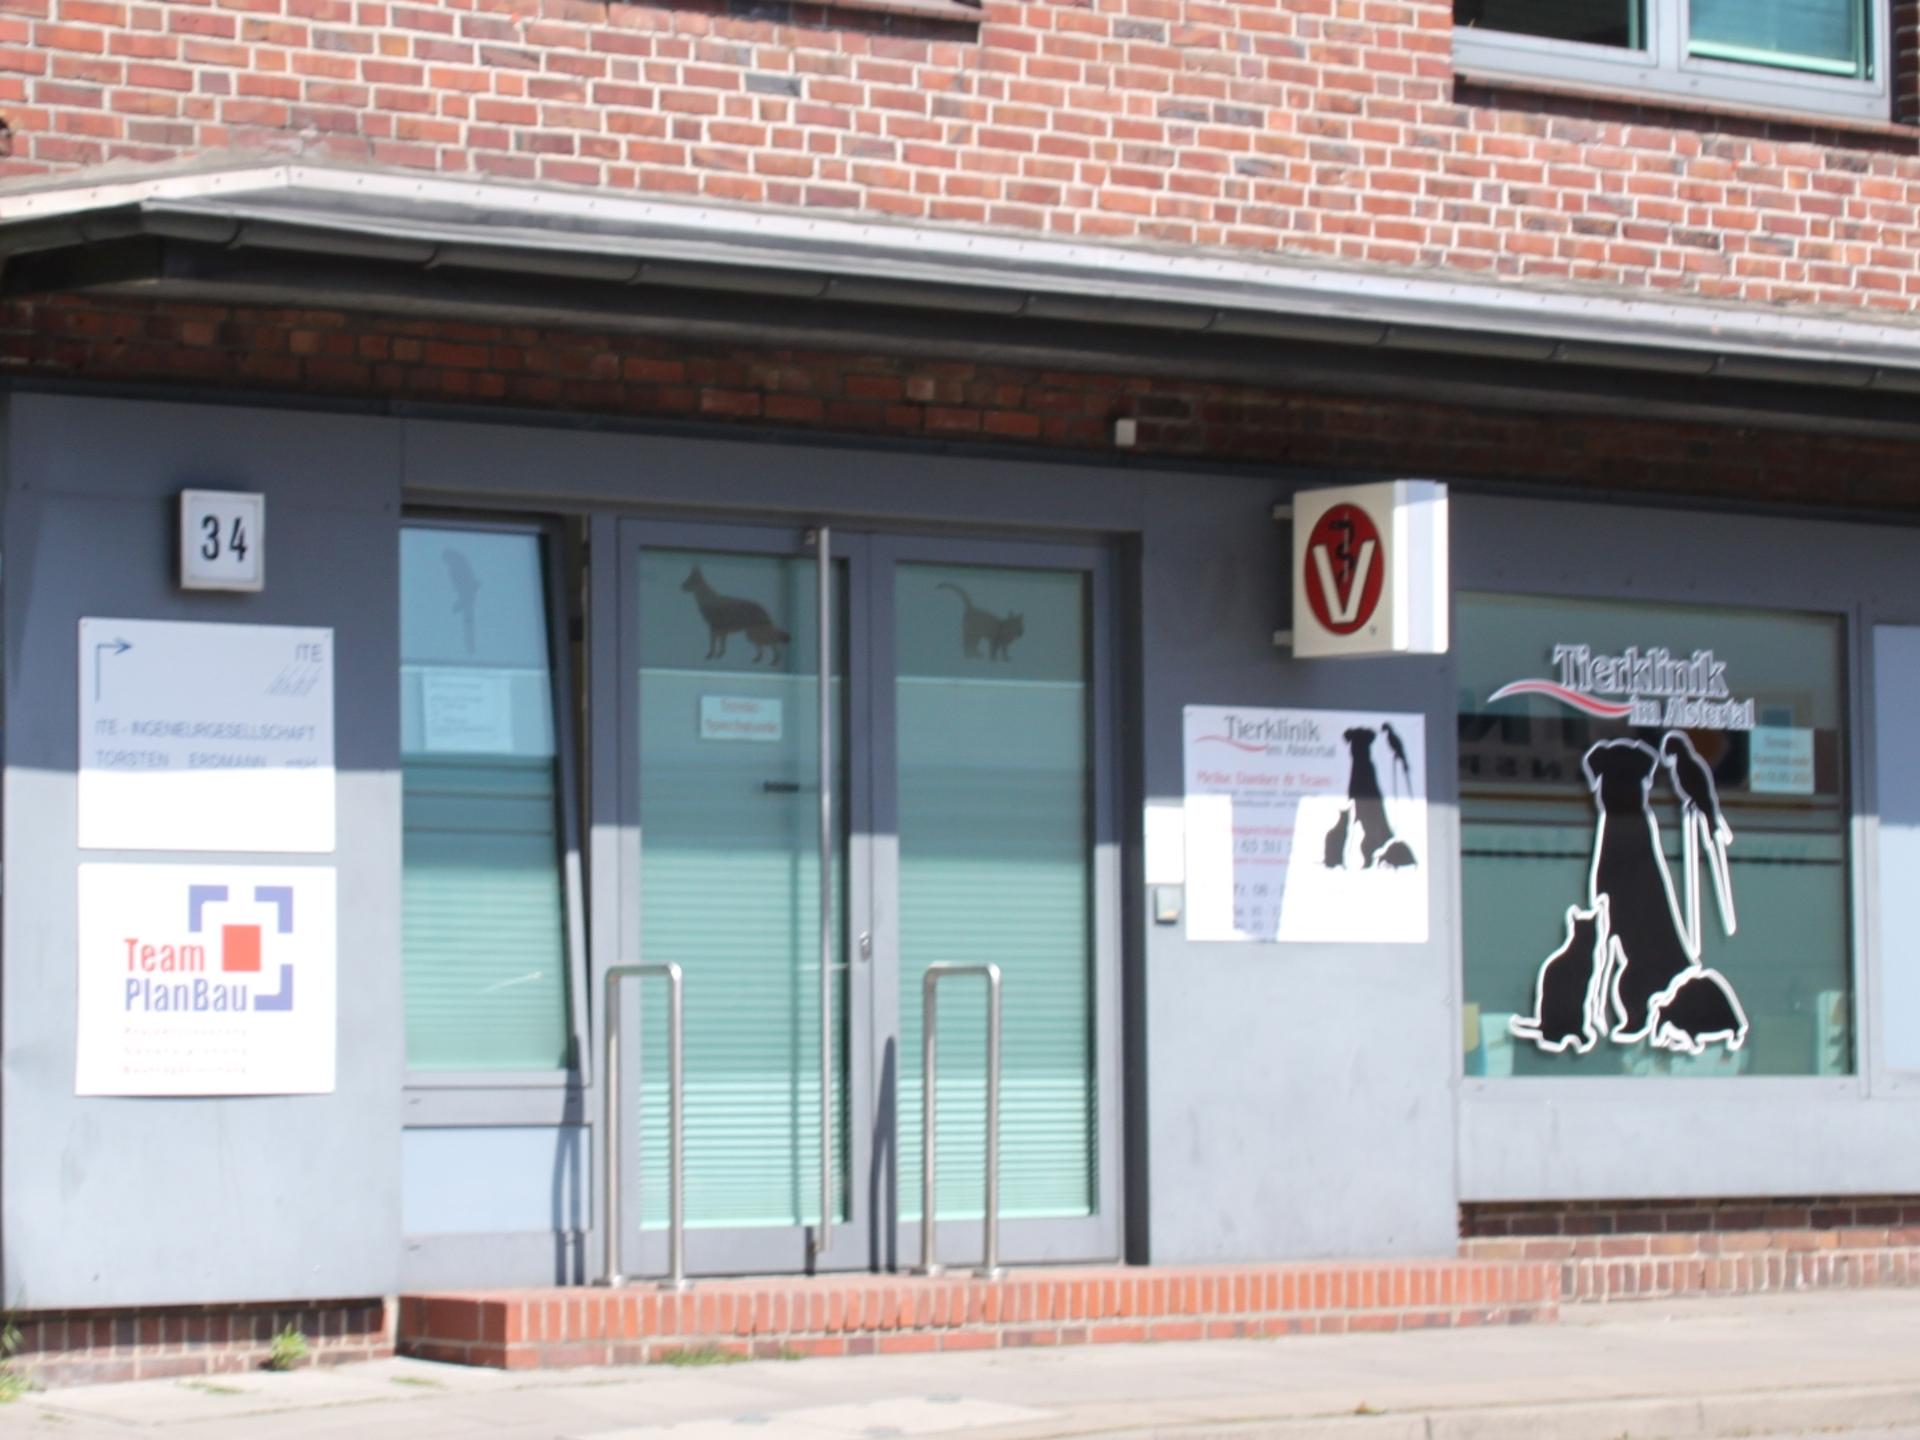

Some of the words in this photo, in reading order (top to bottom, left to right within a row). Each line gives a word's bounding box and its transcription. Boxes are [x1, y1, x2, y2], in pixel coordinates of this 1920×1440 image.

[201, 514, 247, 562] 34
[295, 642, 323, 662] ITE
[1552, 643, 1730, 697] Tierklinik
[1224, 715, 1321, 742] Tierklinik
[124, 938, 204, 972] Team
[125, 978, 247, 1012] PlanBau
